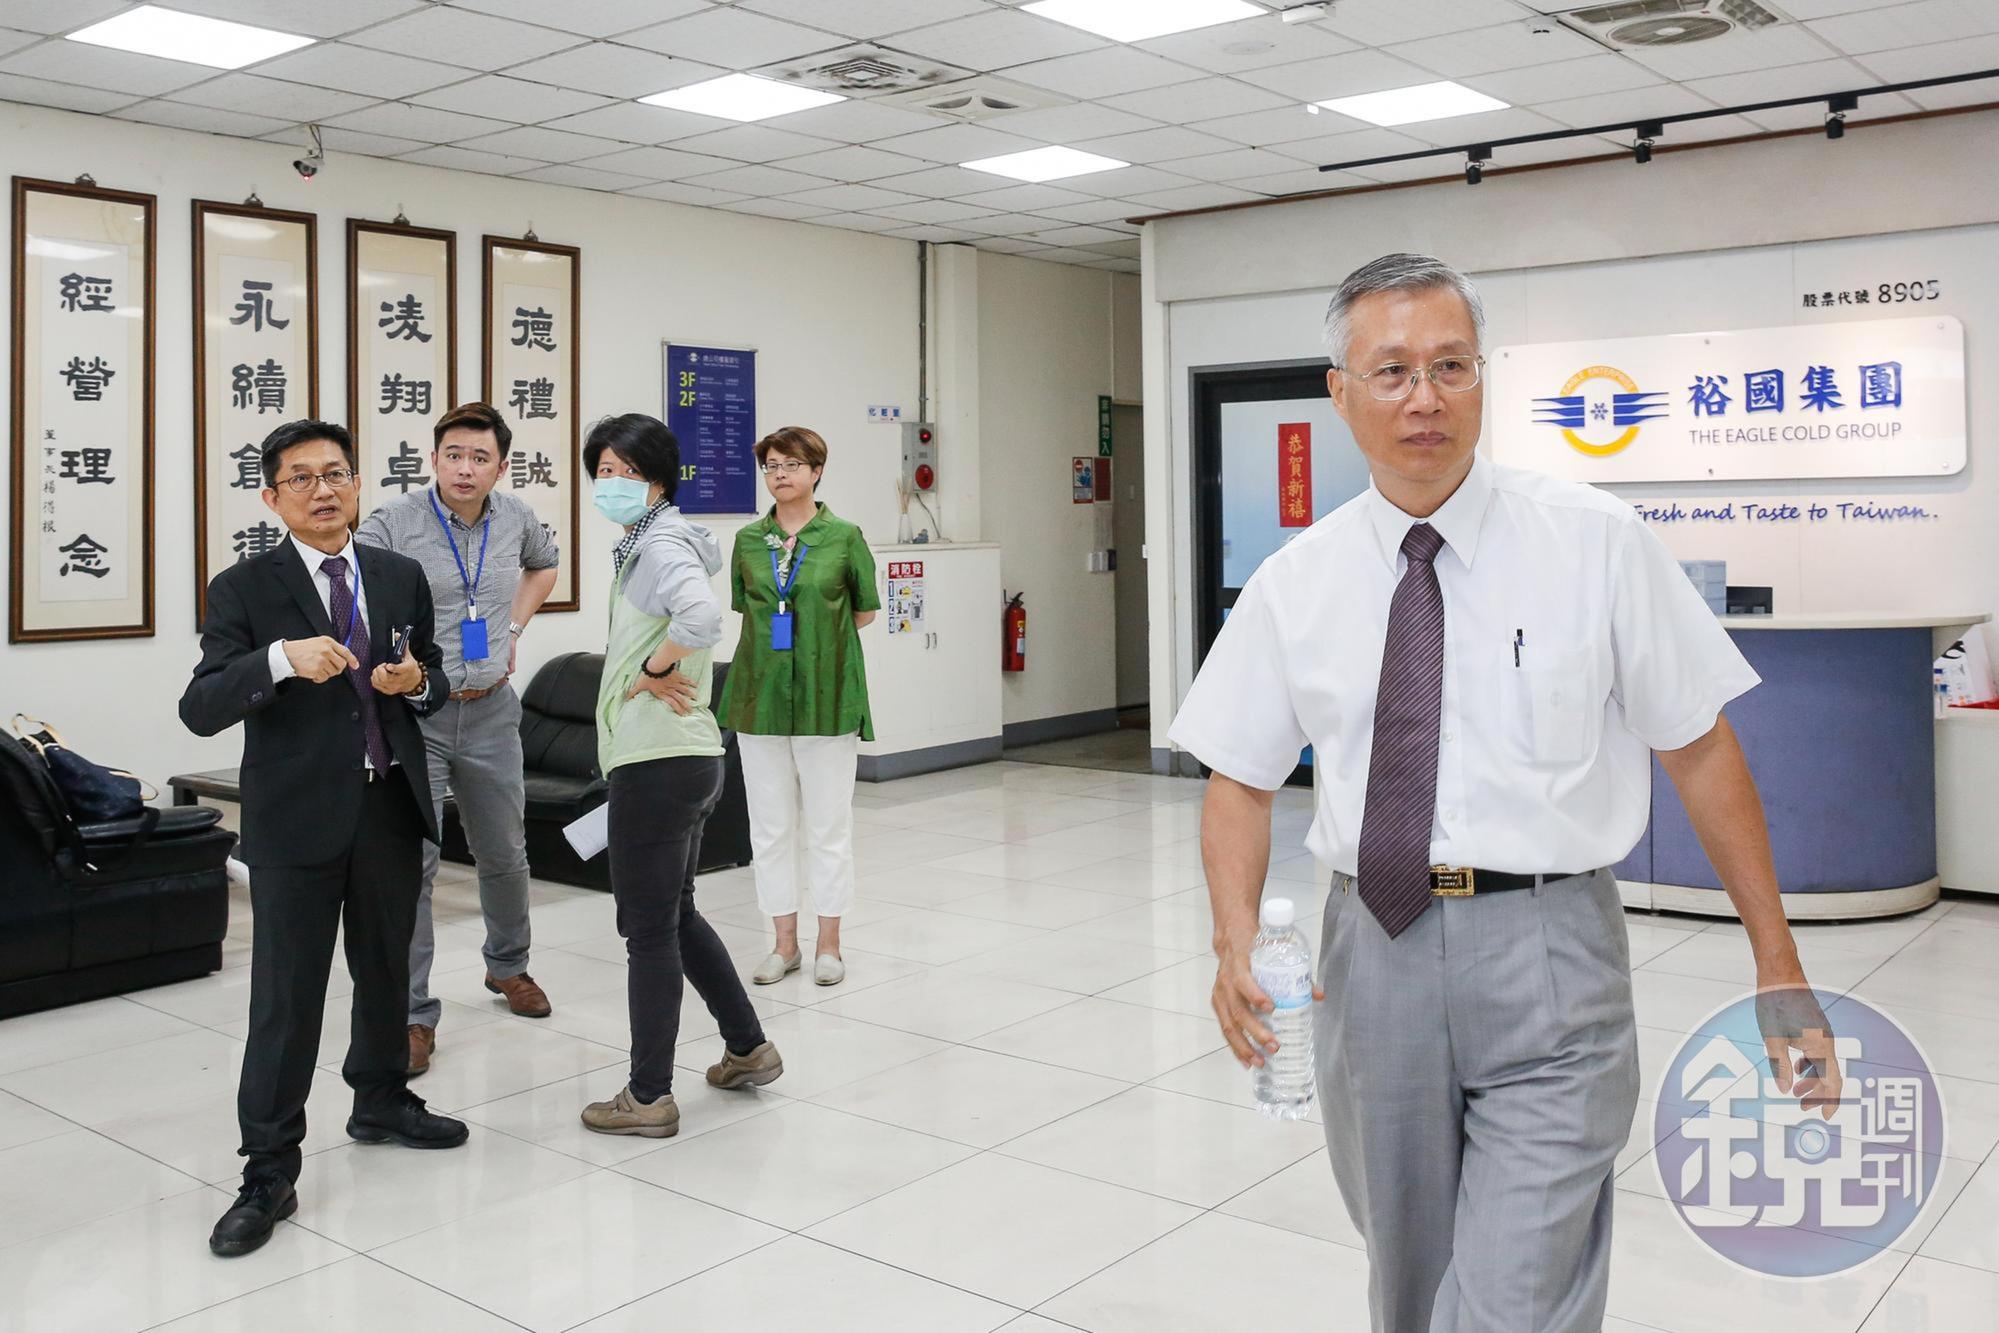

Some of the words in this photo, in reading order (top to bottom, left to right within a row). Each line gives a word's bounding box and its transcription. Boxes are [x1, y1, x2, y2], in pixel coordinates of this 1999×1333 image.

[1802, 289, 1870, 308] 股票代號
[1878, 279, 1940, 304] 8905
[679, 371, 697, 388] 3F
[1687, 360, 1903, 417] 裕國集團
[679, 391, 697, 407] 2F
[58, 272, 116, 579] 經營理念
[508, 306, 559, 553] 德禮誠
[1689, 429, 1721, 445] THE
[1726, 427, 1778, 444] EAGLE
[1782, 424, 1831, 442] COLD
[1836, 421, 1902, 440] GROUP
[680, 464, 697, 481] 1F
[1287, 433, 1306, 519] 恭賀新禧
[1691, 503, 1736, 521] and
[1742, 503, 1801, 521] Taste
[1808, 503, 1828, 520] to
[1836, 502, 1939, 521] Taiwan.
